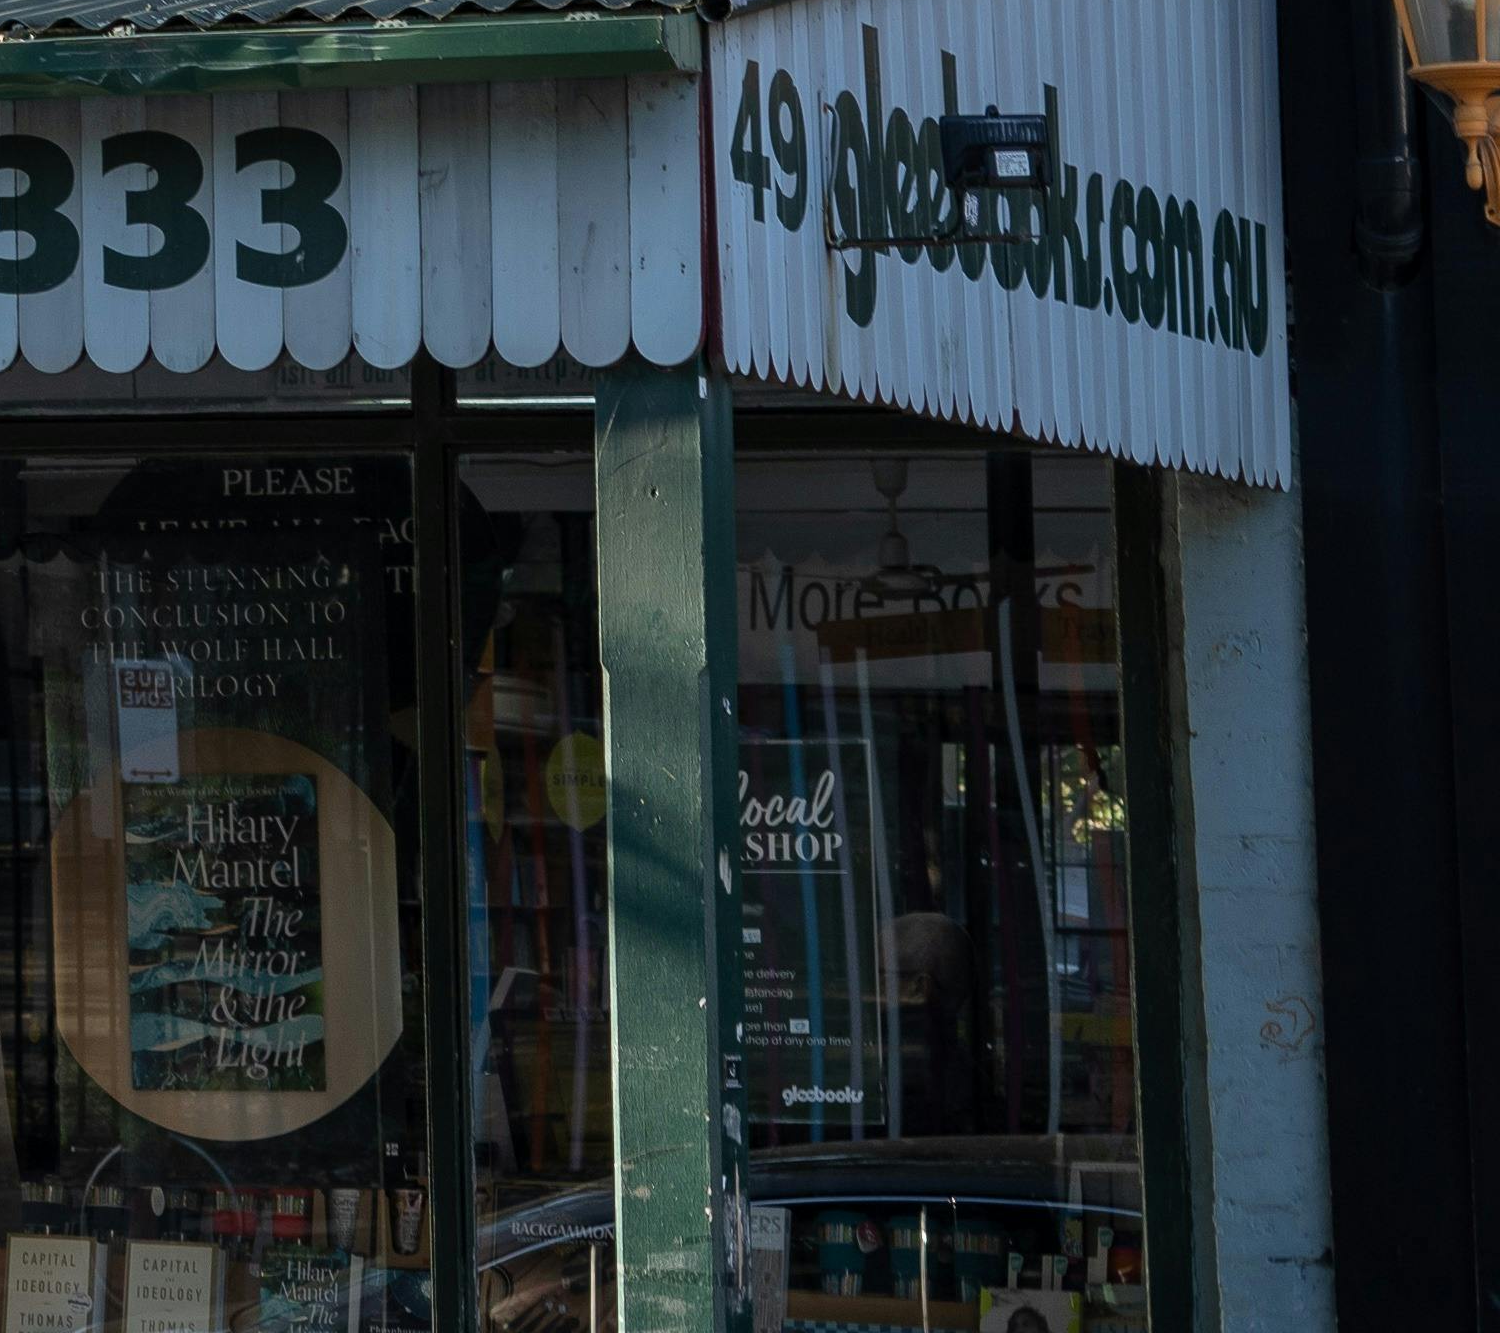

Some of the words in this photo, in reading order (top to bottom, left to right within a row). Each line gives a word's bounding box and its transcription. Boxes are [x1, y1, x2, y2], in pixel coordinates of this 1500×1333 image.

[730, 60, 808, 231] 49
[222, 467, 355, 497] PLEASE
[97, 567, 152, 595] THE
[166, 565, 332, 593] STUNNING
[750, 566, 884, 632] More
[80, 600, 291, 629] CONCLUSION
[306, 599, 346, 625] TO
[87, 640, 145, 664] THE
[160, 638, 250, 662] WOLF
[262, 636, 343, 662] HALL
[186, 800, 300, 855] Hilary
[741, 832, 844, 862] SHOP
[171, 846, 301, 889] Mantel
[244, 895, 304, 938] The
[191, 936, 307, 979] Mirror
[211, 983, 248, 1030] &
[250, 983, 307, 1023] the
[216, 1025, 308, 1081] Light
[781, 1085, 864, 1107] gleebooks
[510, 1220, 615, 1241] BACKGAMMON
[22, 1251, 76, 1268] CAPITAL
[142, 1258, 198, 1275] CAPITAL
[286, 1259, 341, 1284] Hilary
[15, 1279, 81, 1295] IDEOLOGY
[136, 1285, 203, 1303] IDEOLOGY
[278, 1282, 340, 1303] Mantel
[19, 1312, 74, 1329] THOMAS
[140, 1319, 196, 1333] THOMAS
[308, 1305, 340, 1326] The
